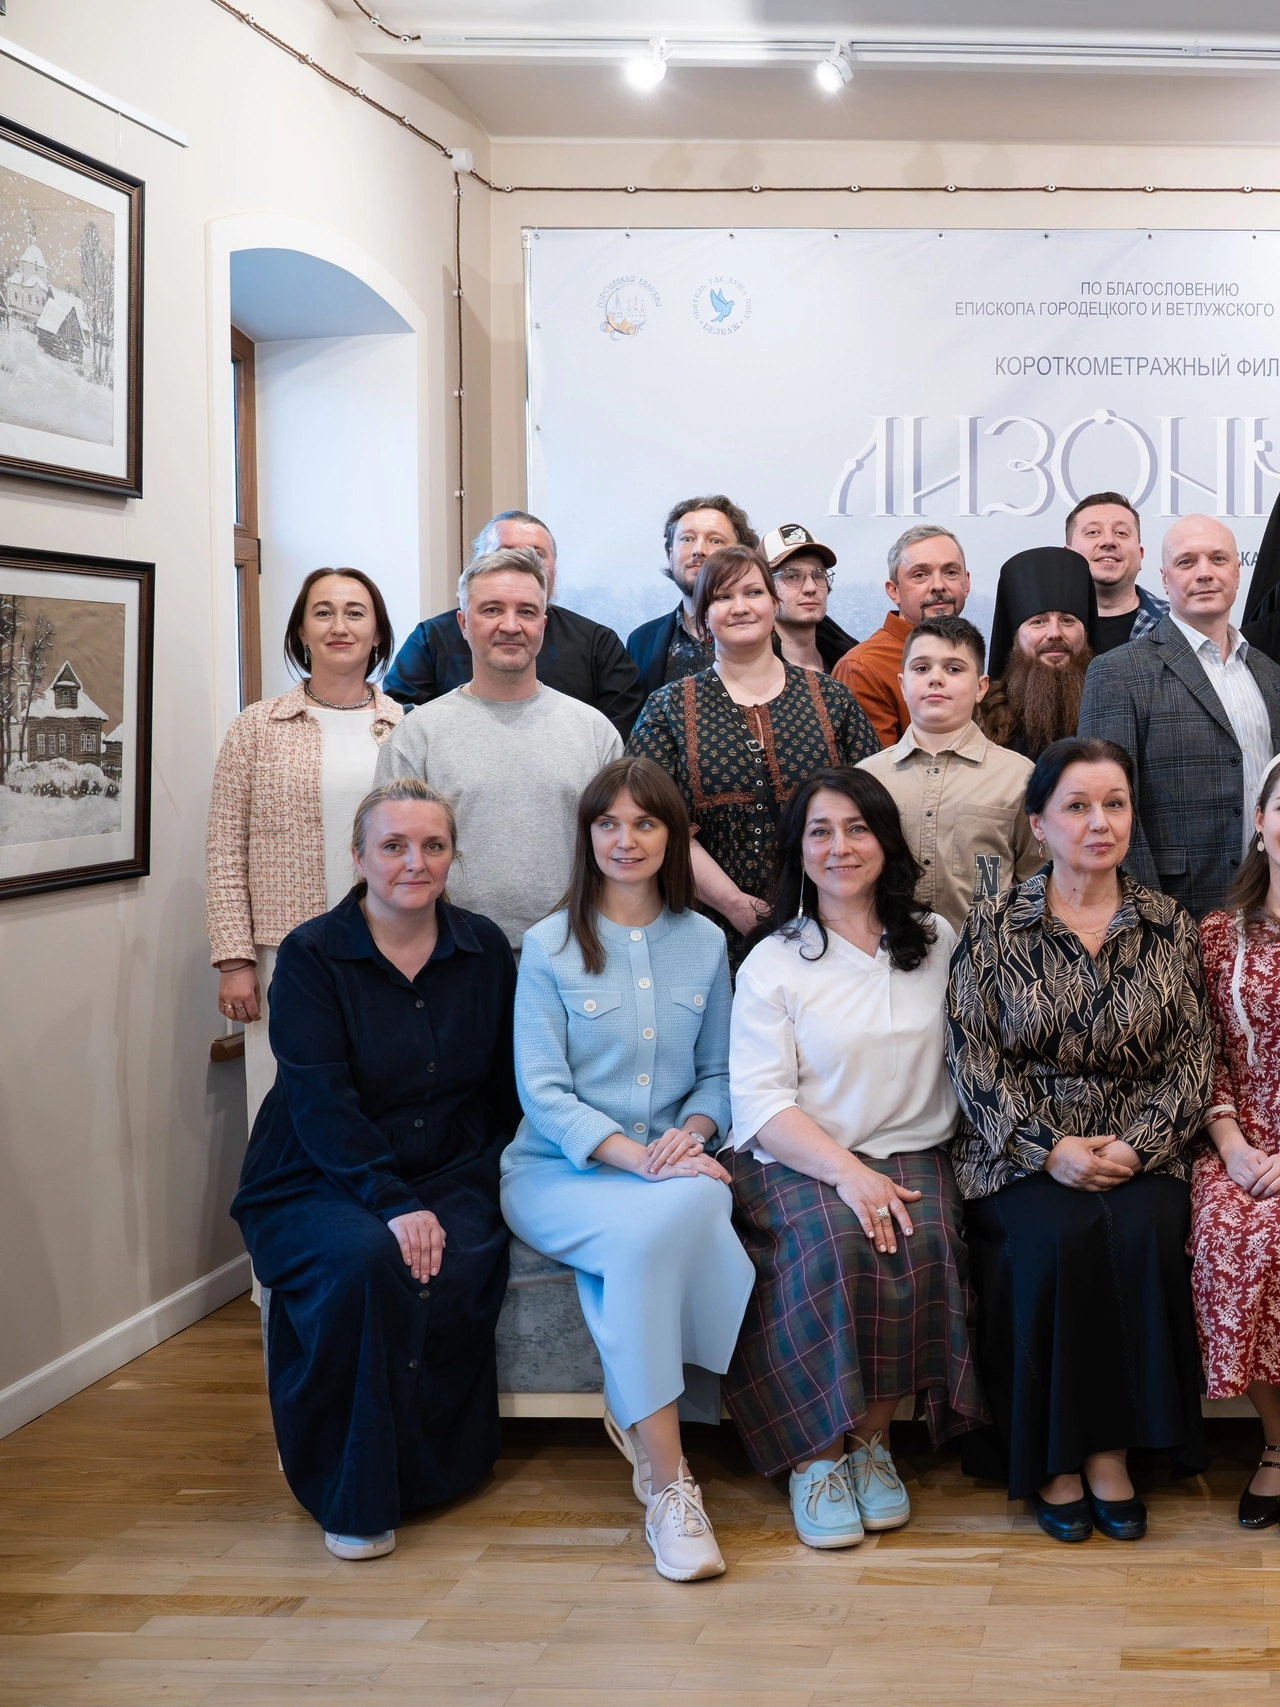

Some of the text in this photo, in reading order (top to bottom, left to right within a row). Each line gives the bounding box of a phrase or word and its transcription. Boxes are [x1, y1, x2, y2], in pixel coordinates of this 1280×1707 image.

[709, 276, 724, 284] ГДЕ
[727, 277, 748, 296] ДУША
[1081, 281, 1240, 297] ПО БЛАГОСЛОВЕНИЮ
[955, 301, 1036, 316] ЕПИСКОПА
[1039, 301, 1147, 319] ГОРОДЕЦКОГО
[1152, 302, 1162, 316] И
[1166, 302, 1275, 317] ВЕТЛУЖСКОГО
[702, 321, 741, 336] БЕЛБАЖ
[995, 353, 1230, 377] КОРОТКОМЕТРАЖНЫЙ
